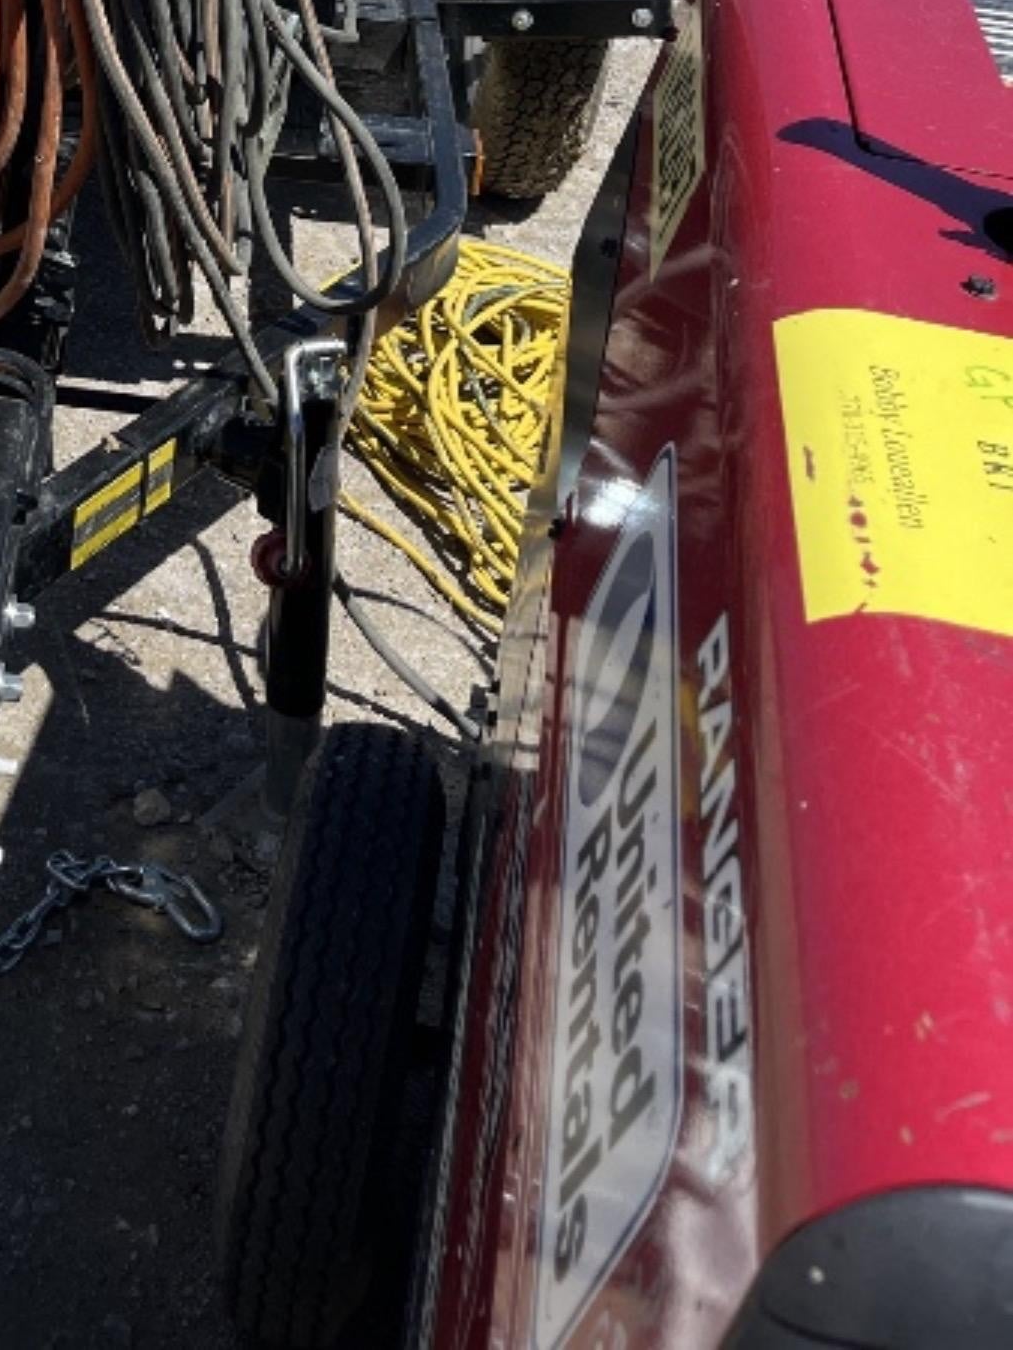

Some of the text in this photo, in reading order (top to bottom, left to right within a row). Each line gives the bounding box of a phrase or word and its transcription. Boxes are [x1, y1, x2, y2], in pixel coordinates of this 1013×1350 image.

[554, 804, 613, 1282] Rentals
[608, 716, 658, 1150] United
[697, 611, 756, 1186] RANGER
